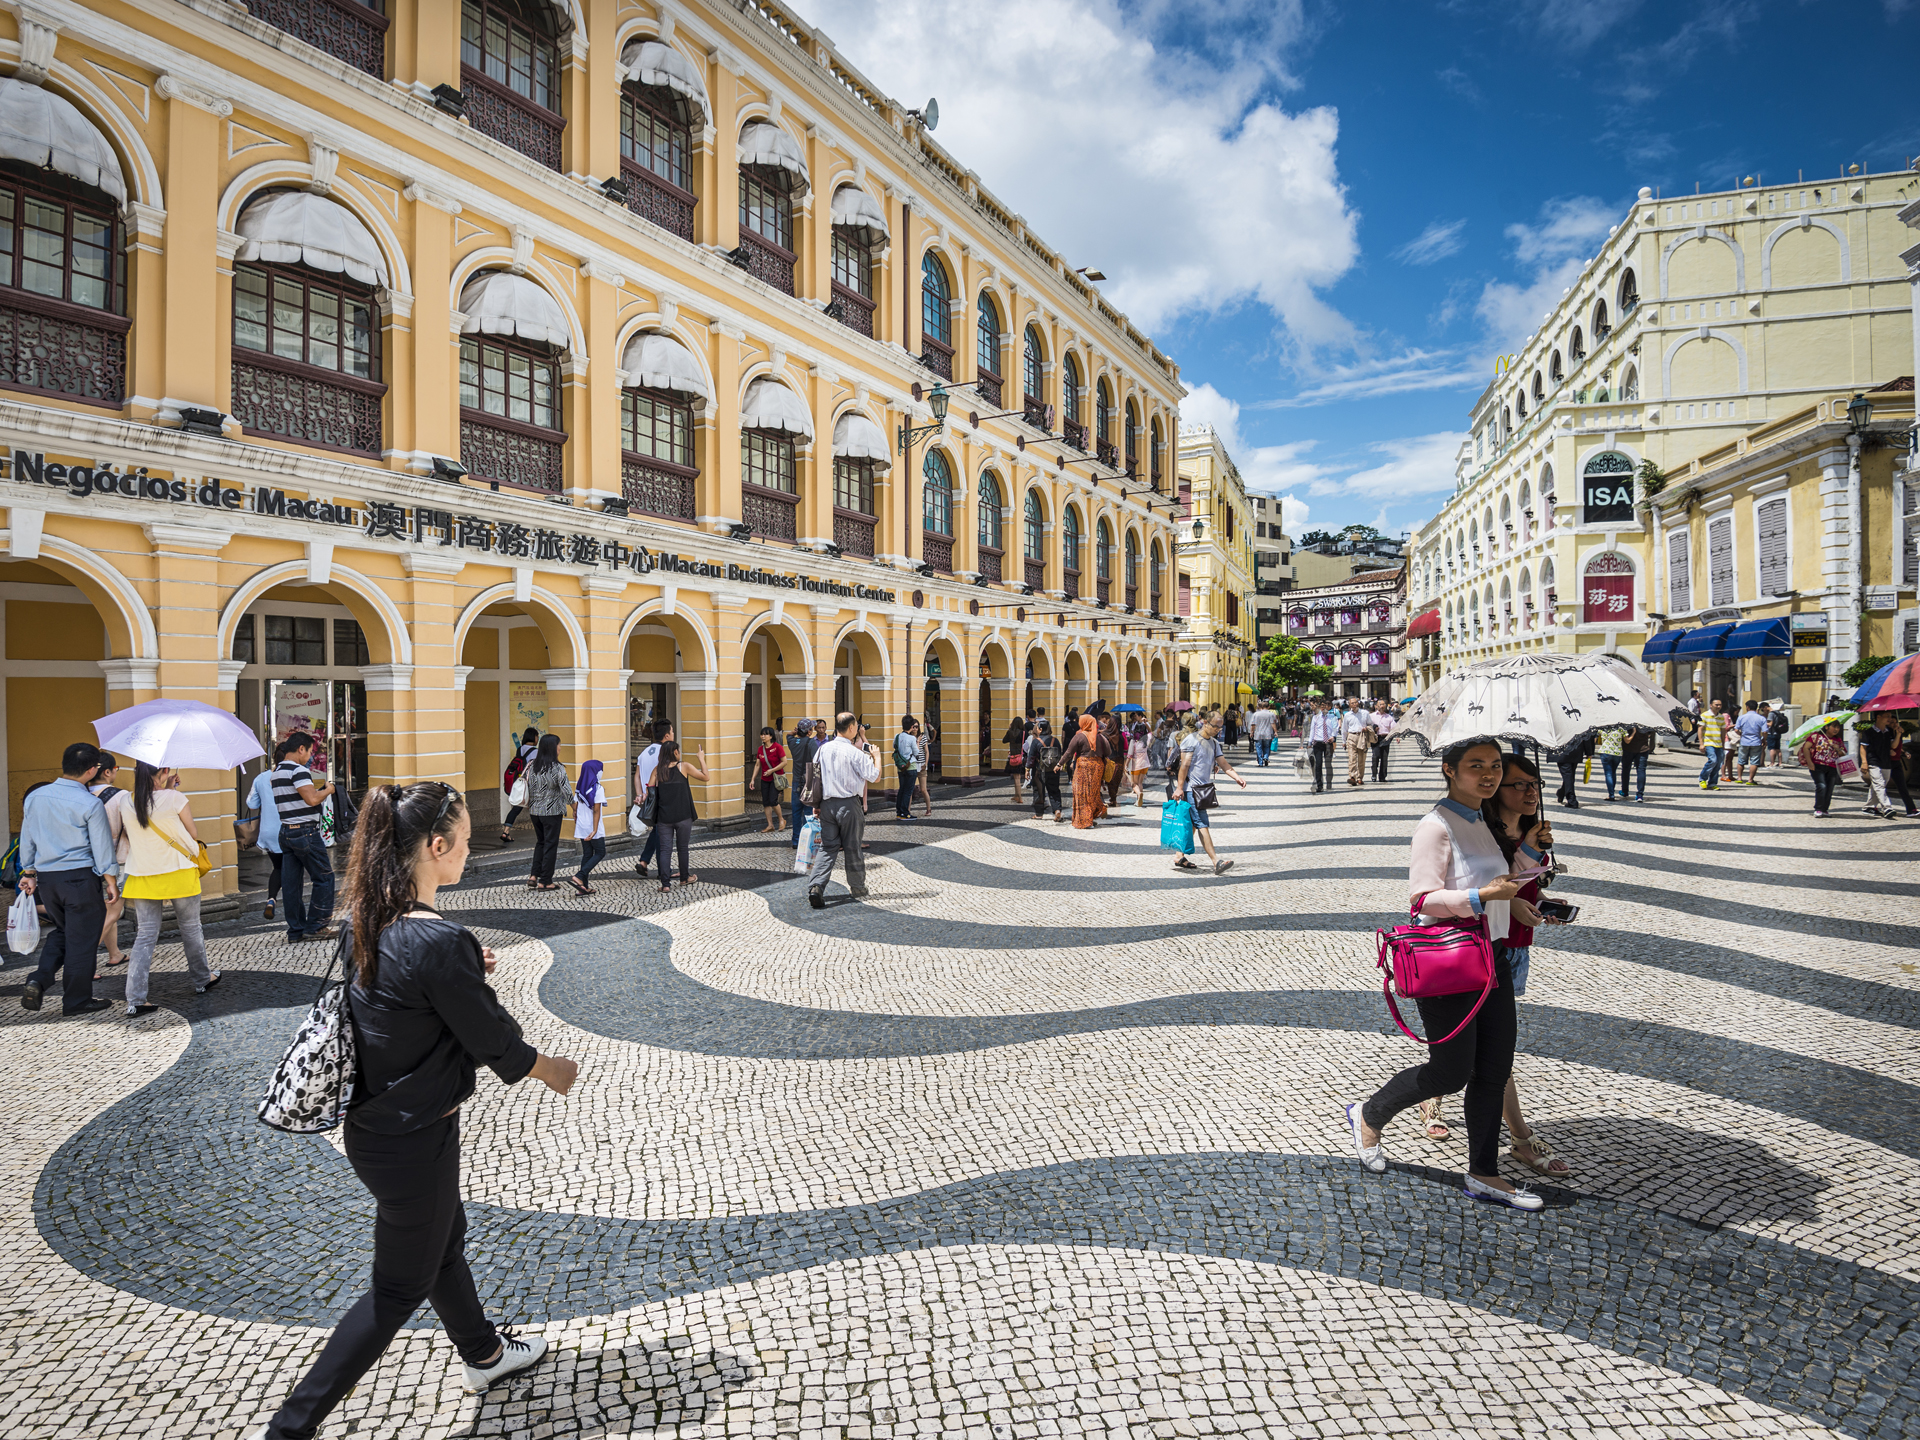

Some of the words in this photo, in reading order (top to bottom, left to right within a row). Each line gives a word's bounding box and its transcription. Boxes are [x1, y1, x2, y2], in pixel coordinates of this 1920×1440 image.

[15, 450, 187, 503] Negócios
[199, 478, 242, 510] de
[256, 487, 353, 525] Macau
[1587, 487, 1631, 507] ISA
[363, 501, 656, 575] 澳門商務旅遊中心
[660, 553, 722, 579] Macau
[728, 563, 796, 590] Business
[799, 575, 852, 597] Tourism
[856, 584, 896, 603] Centre
[1317, 594, 1367, 608] SWAROVSKI
[1588, 588, 1629, 613] 莎莎
